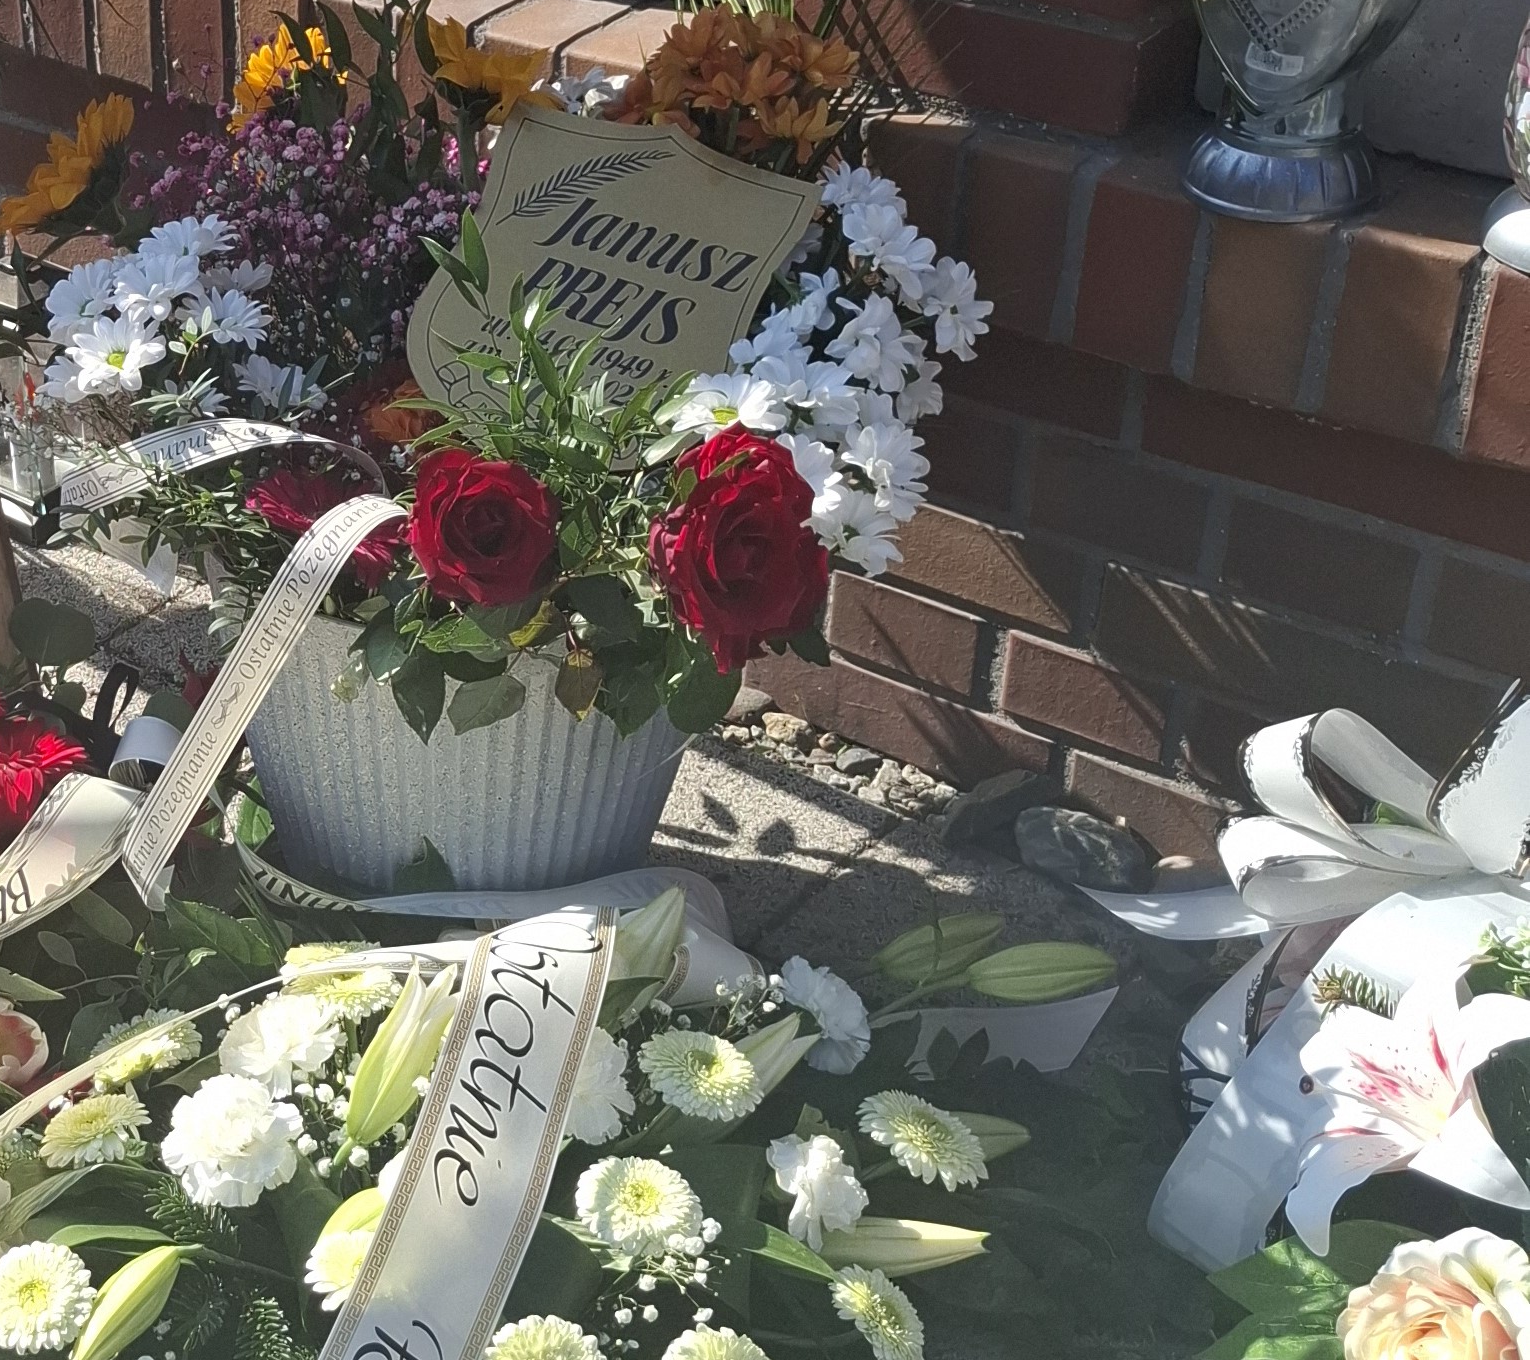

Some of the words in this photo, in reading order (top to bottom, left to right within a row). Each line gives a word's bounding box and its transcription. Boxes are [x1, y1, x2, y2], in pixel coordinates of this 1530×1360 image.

[532, 196, 759, 294] Janusz
[523, 256, 697, 346] PREJS
[240, 599, 297, 681] Ostatnie
[432, 921, 604, 1208] Ostatnie
